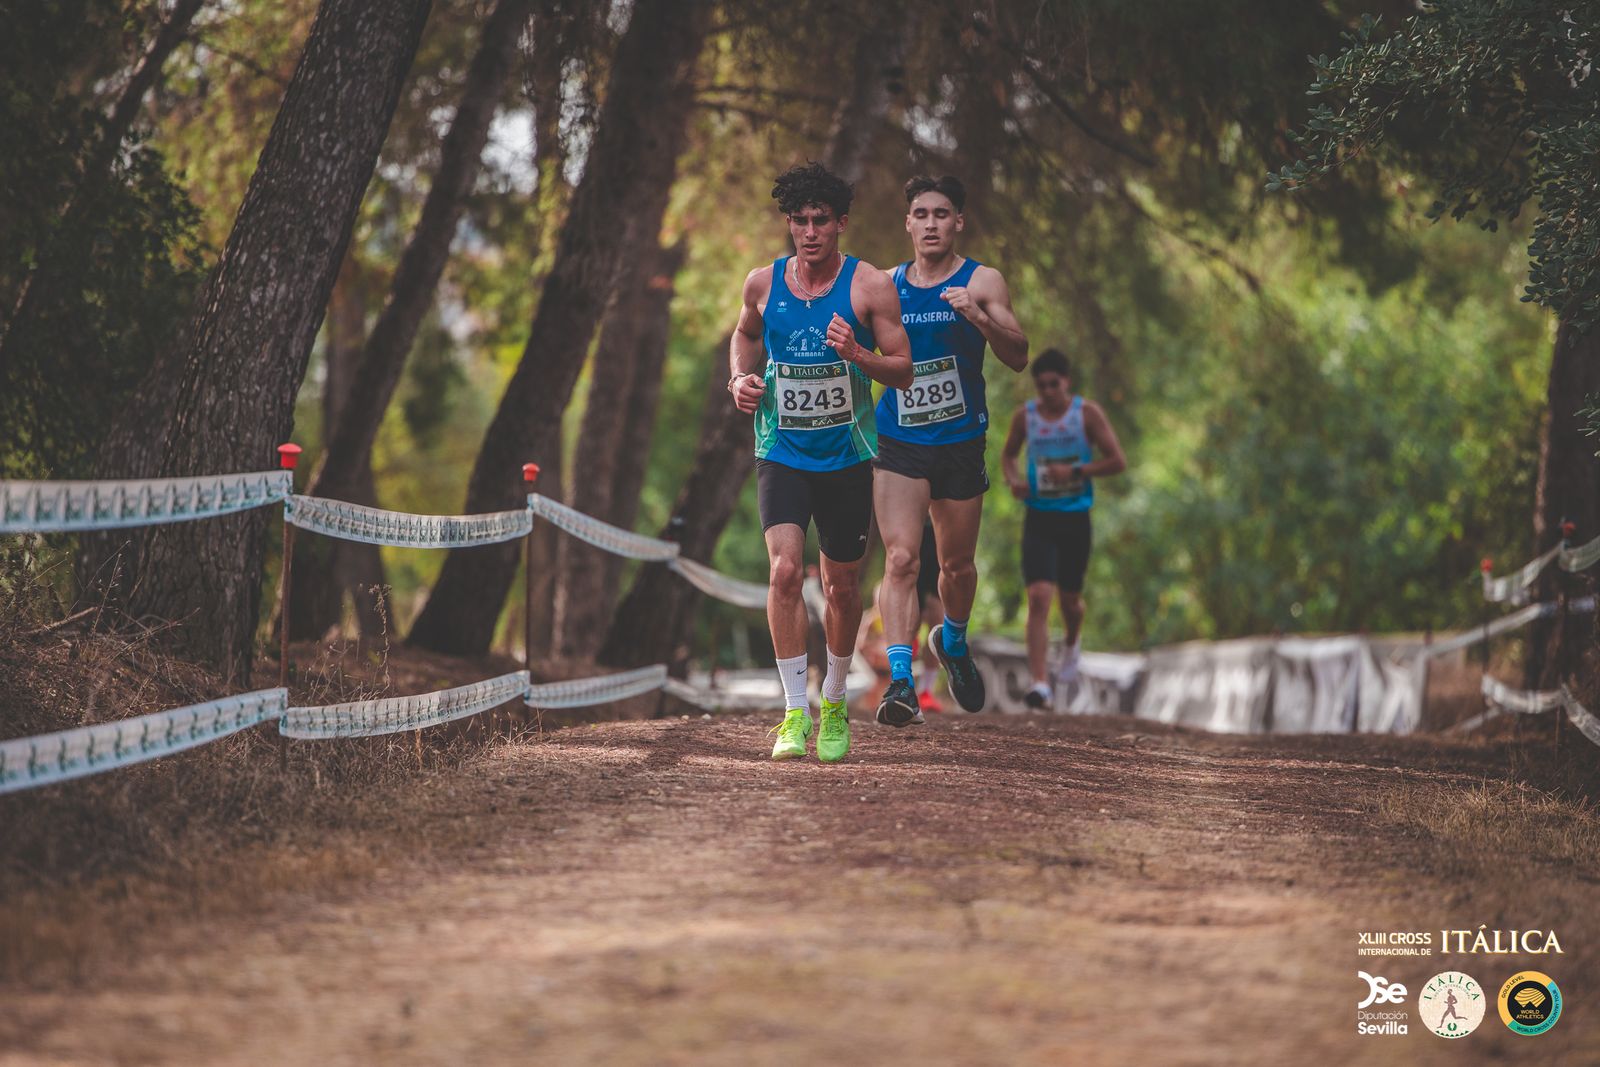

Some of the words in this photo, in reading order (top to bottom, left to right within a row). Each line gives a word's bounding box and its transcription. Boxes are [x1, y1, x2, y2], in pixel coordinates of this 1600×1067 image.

[901, 311, 956, 325] OTASIERRA
[783, 387, 847, 411] 8243
[903, 380, 957, 409] 8289
